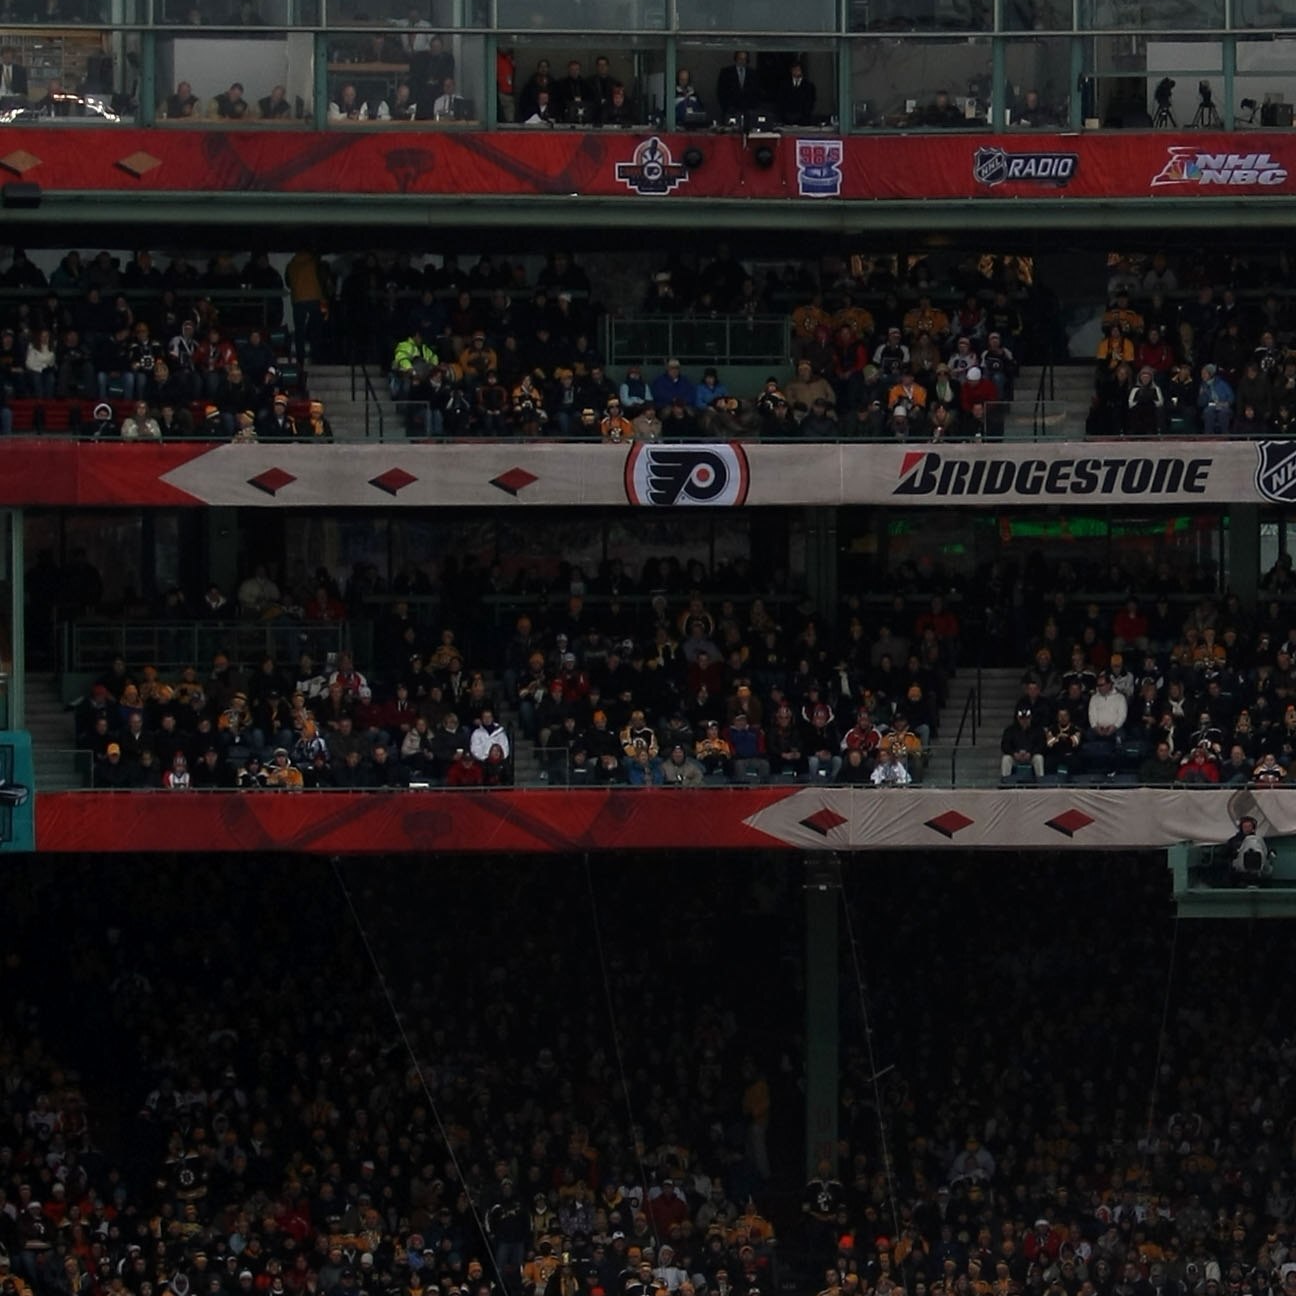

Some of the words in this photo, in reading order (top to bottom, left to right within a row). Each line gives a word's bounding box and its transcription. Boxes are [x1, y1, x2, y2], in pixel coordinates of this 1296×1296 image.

[981, 158, 1002, 180] NHL
[1007, 157, 1074, 180] RADIO
[1197, 153, 1282, 171] NHL
[1198, 170, 1288, 185] NBC
[893, 452, 1212, 495] BRIDGESTONE
